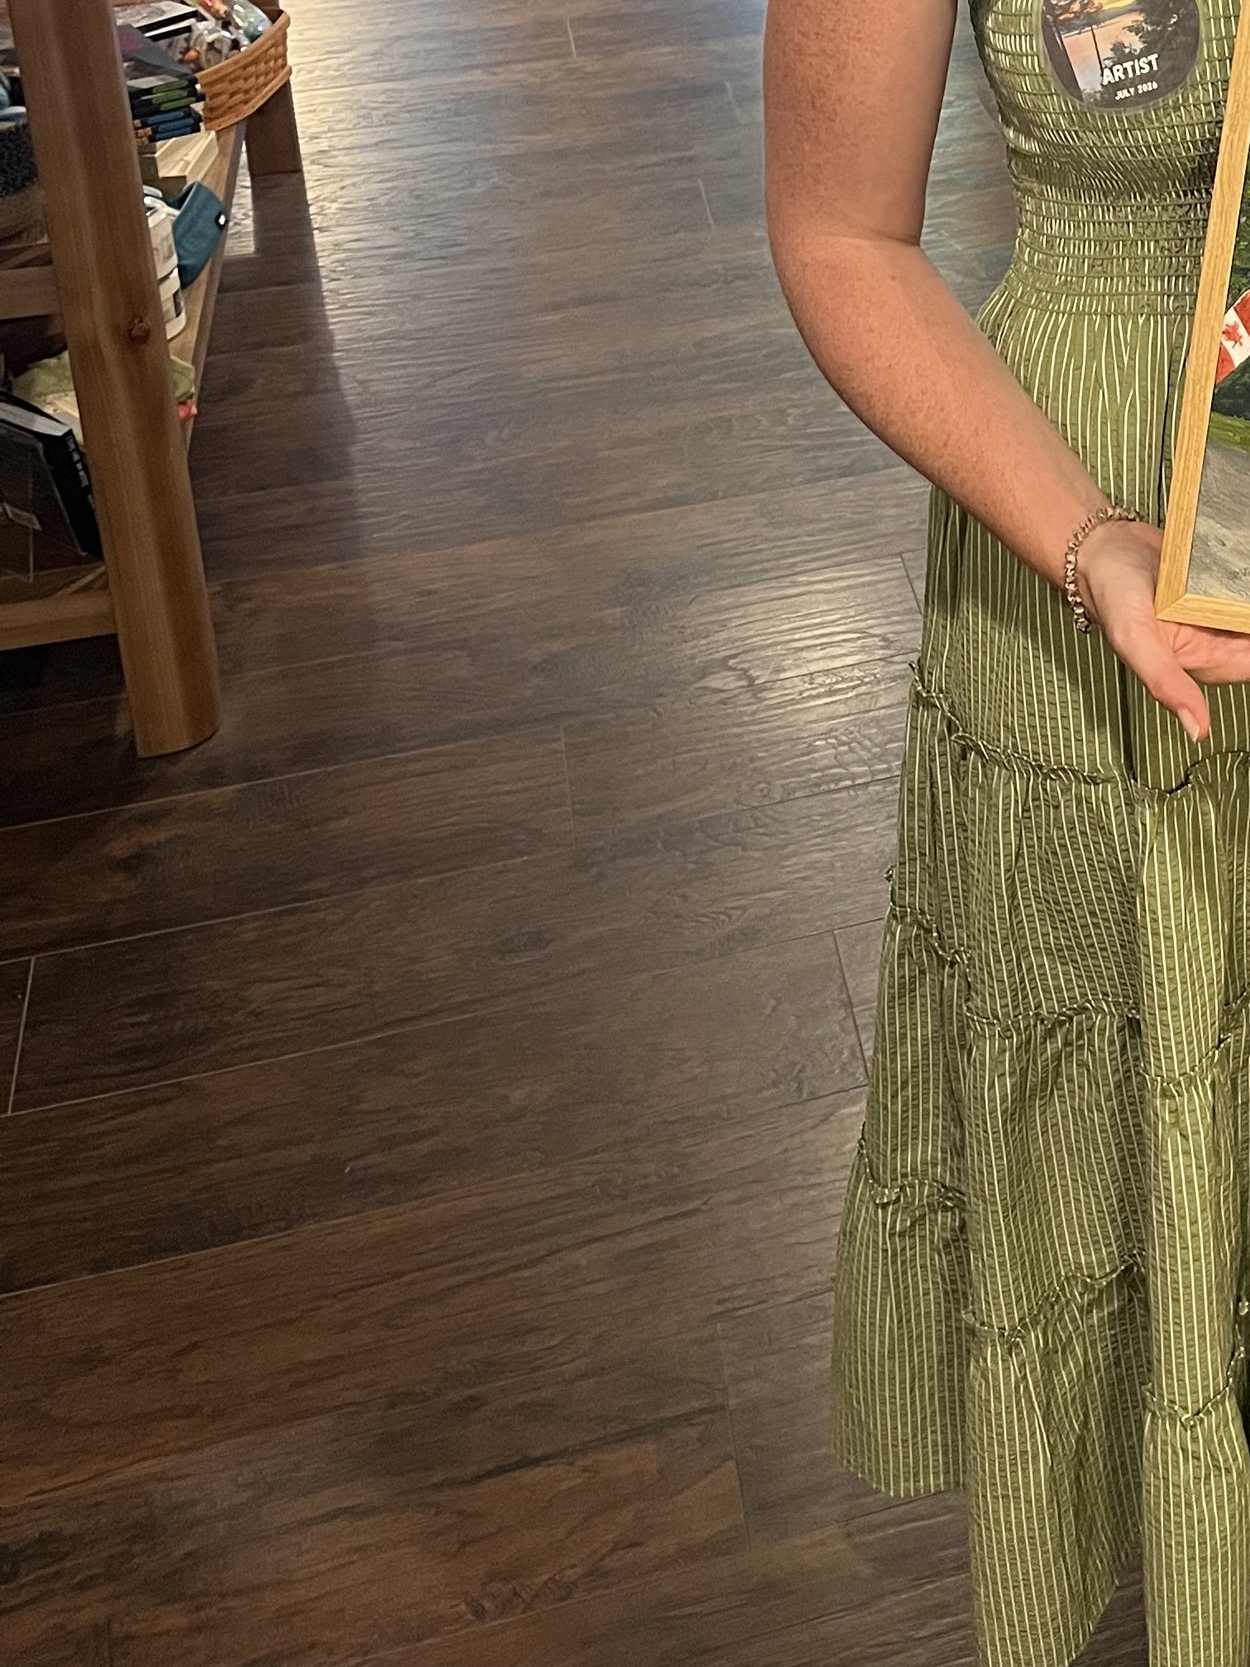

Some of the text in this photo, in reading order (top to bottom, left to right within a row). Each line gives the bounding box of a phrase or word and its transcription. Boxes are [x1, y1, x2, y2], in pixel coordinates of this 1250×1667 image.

[1102, 53, 1159, 86] ARTIST
[1115, 81, 1159, 101] JULY 2026
